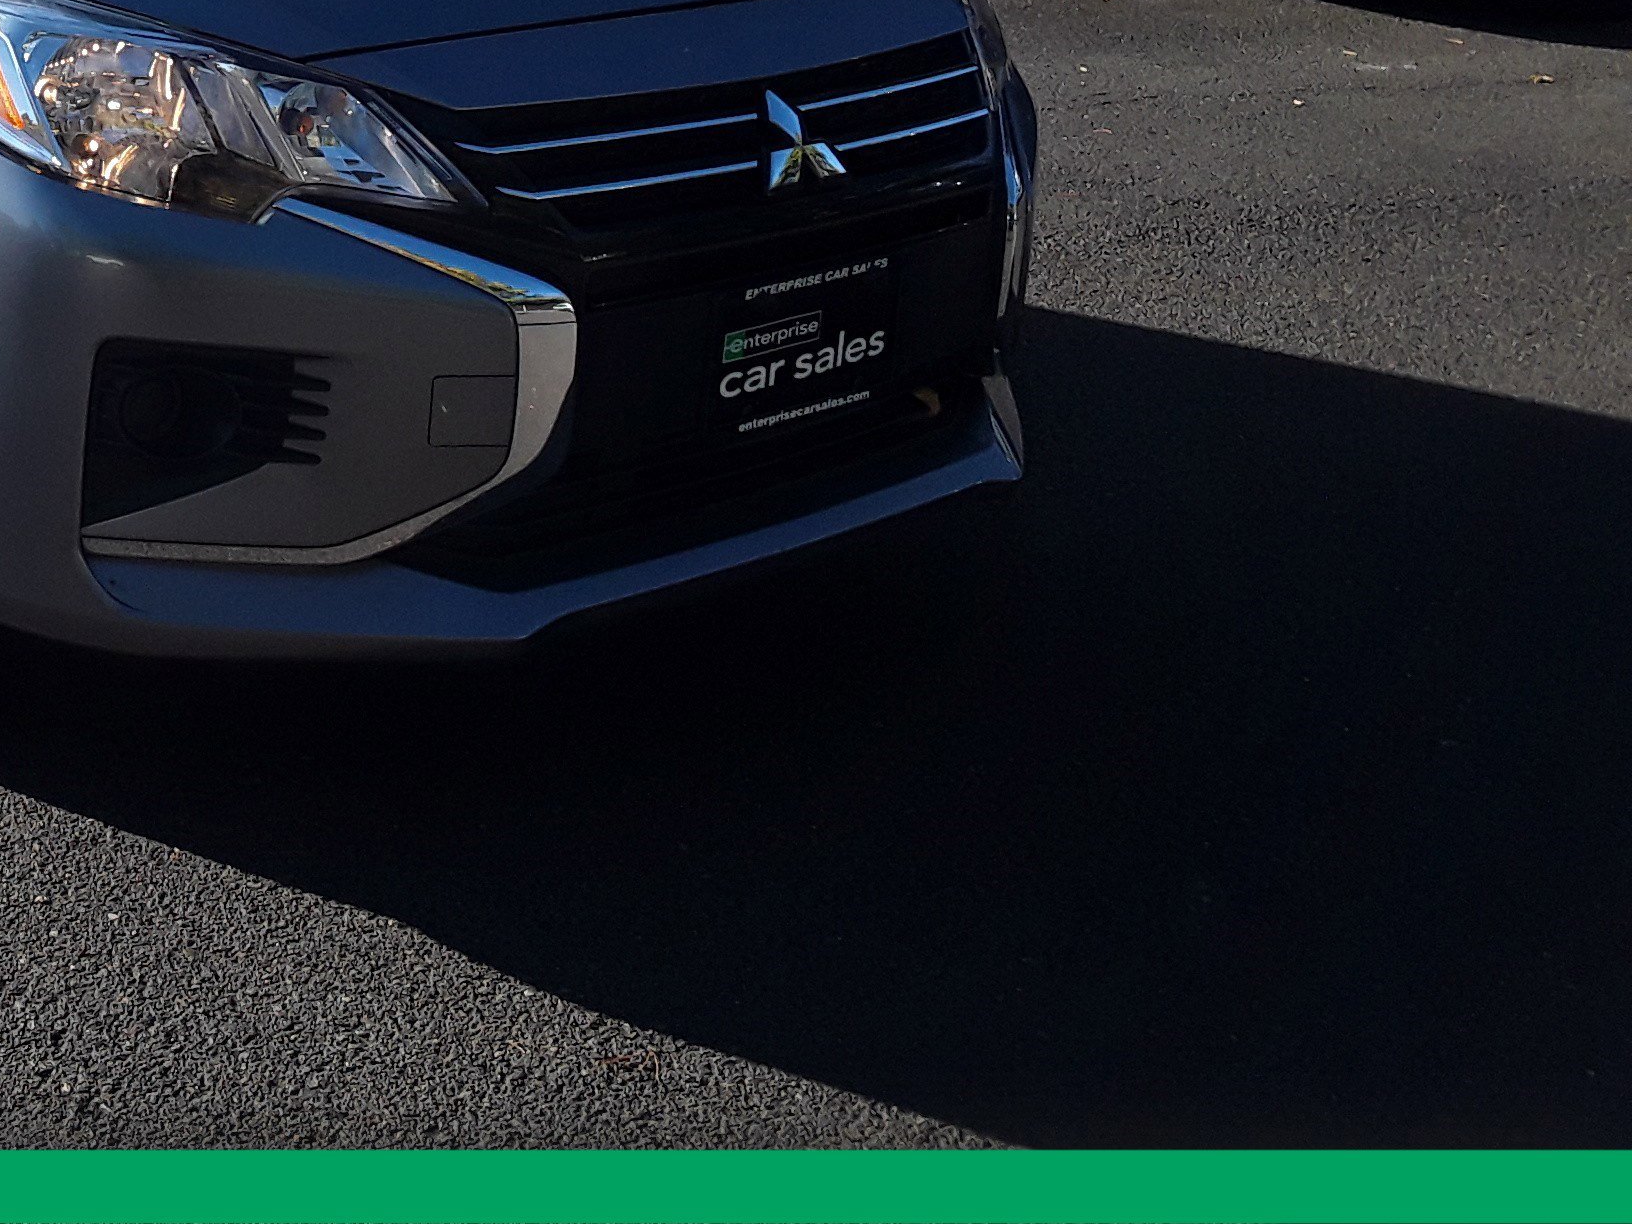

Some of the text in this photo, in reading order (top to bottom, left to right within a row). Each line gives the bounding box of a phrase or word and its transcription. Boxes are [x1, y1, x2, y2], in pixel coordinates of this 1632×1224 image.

[824, 267, 849, 282] CAR
[727, 320, 819, 353] enterprise
[719, 330, 885, 399] car sales
[738, 390, 870, 433] enterprisecarsales.com
